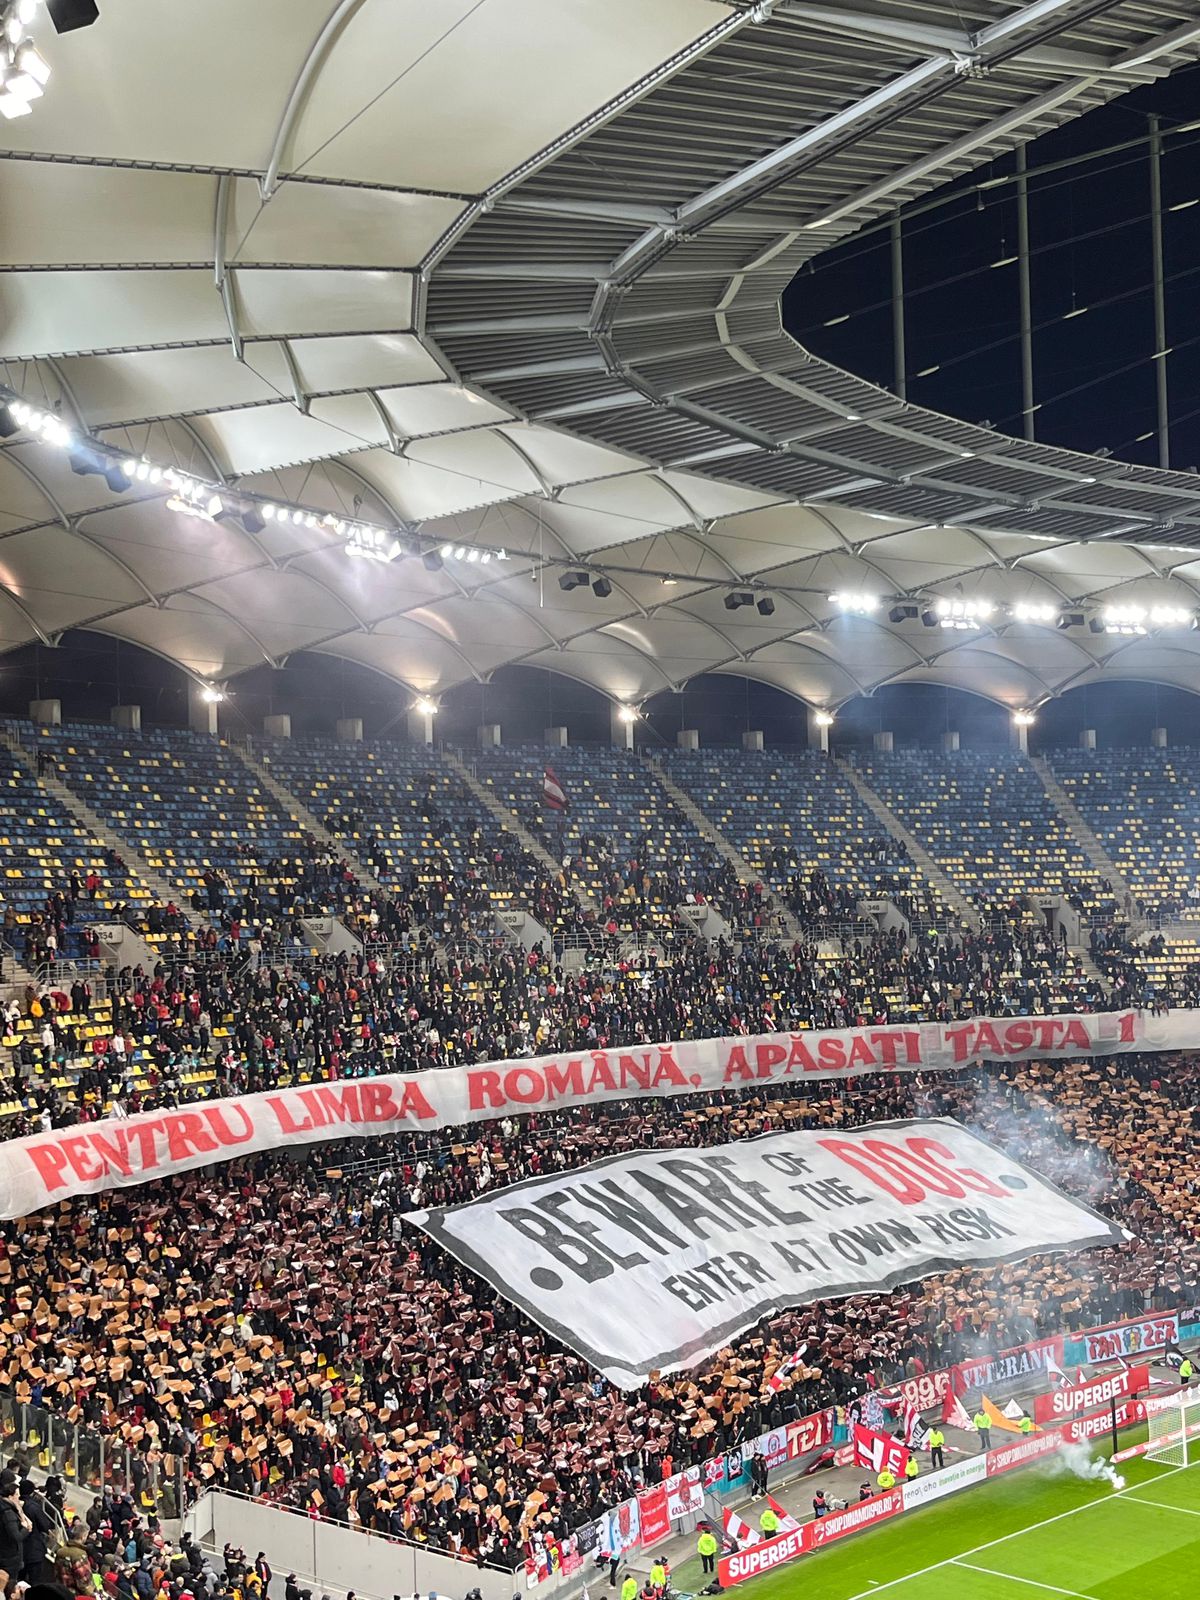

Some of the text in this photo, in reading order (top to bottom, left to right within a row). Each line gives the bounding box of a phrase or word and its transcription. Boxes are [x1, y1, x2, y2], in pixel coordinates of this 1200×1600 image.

[310, 923, 324, 931] 352
[26, 1103, 255, 1193] PENTRU
[267, 1080, 438, 1135] LIMBA
[945, 1019, 1092, 1063] TASTA
[1117, 1013, 1136, 1043] 1
[499, 1137, 1016, 1285] BEWARE OF THE DOG
[660, 1207, 1017, 1312] ENTER AT OWN RISK
[1052, 1370, 1130, 1413] SUPERBET
[1070, 1403, 1128, 1439] SUPERBET
[728, 1527, 804, 1577] SUPERBET
